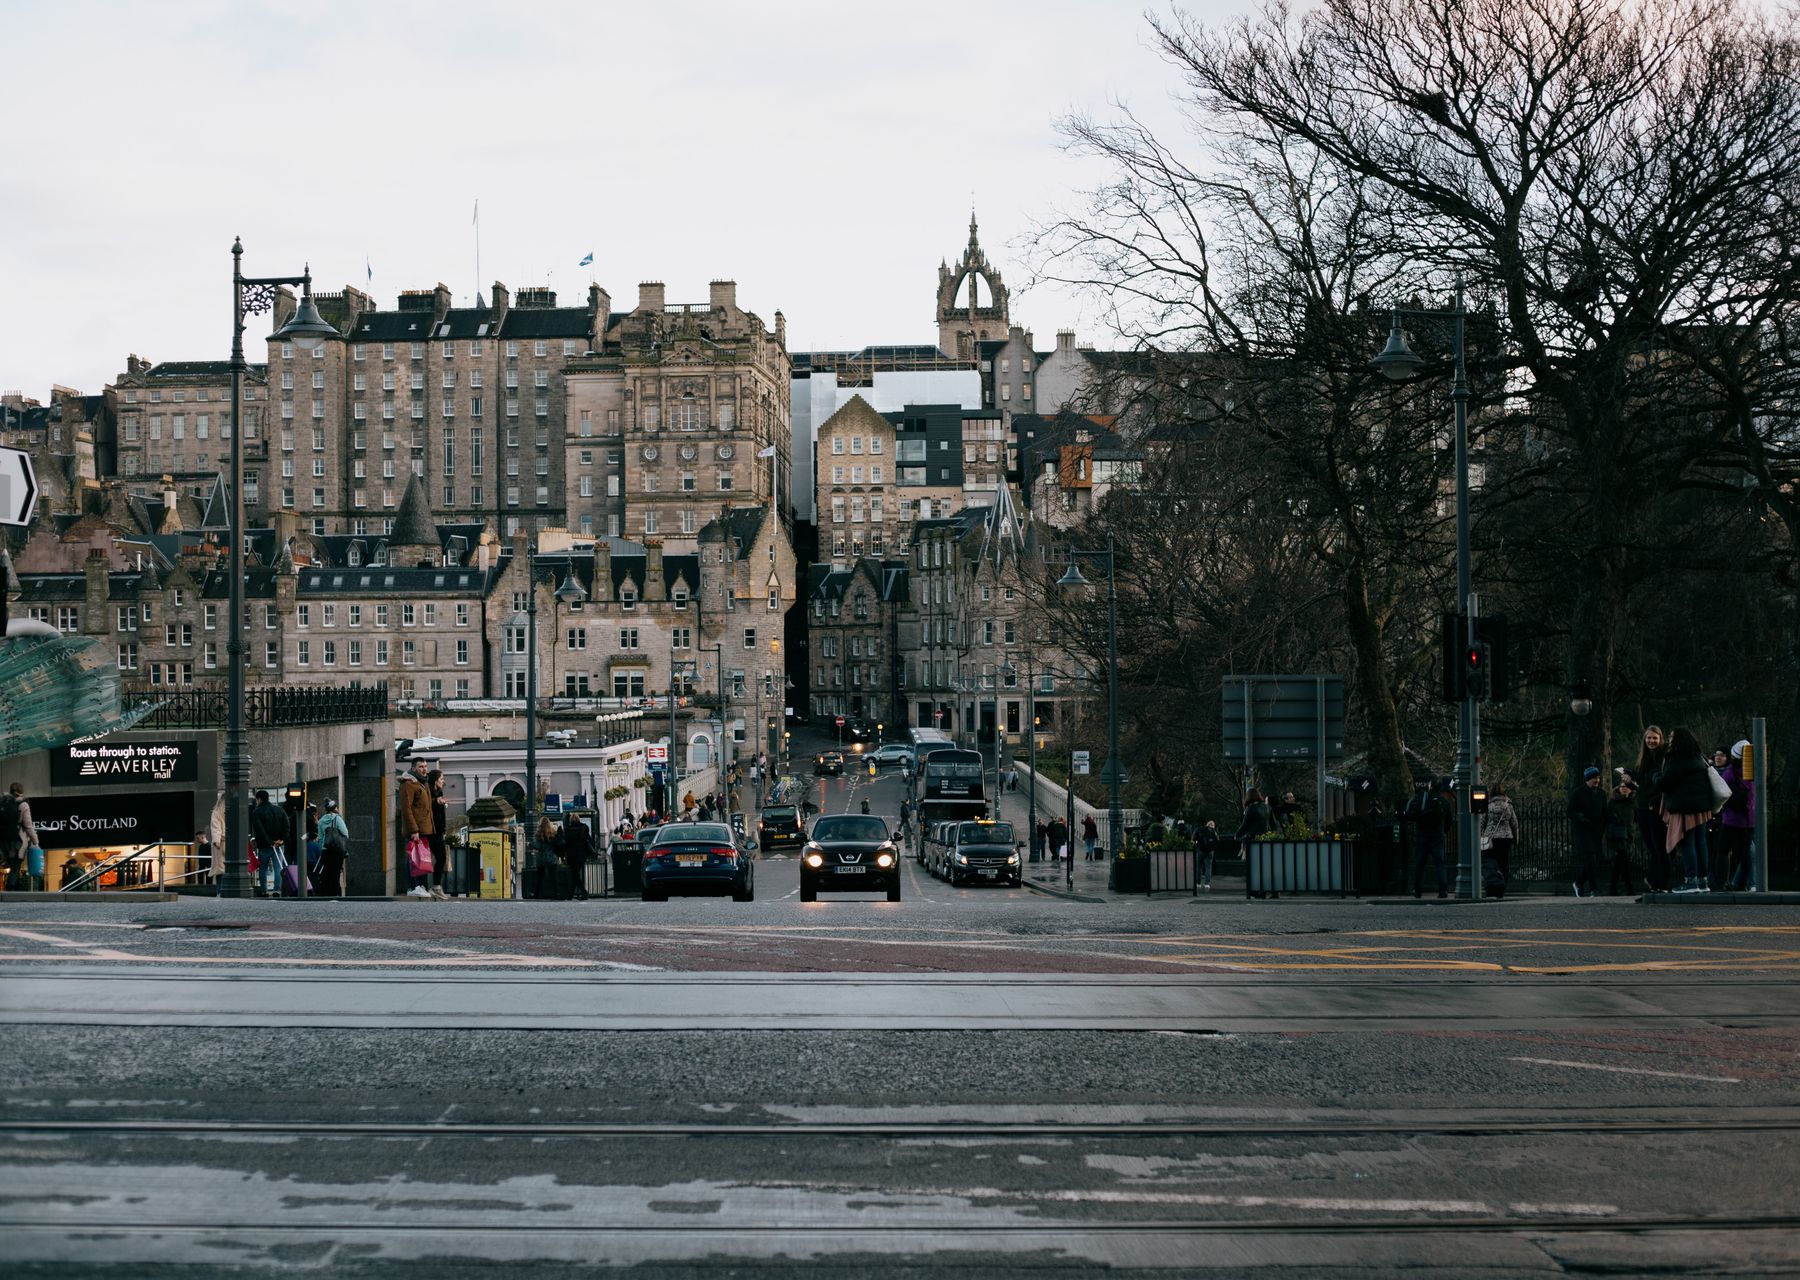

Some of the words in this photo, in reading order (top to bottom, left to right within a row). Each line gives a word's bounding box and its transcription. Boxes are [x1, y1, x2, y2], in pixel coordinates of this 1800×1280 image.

[70, 747, 97, 758] Route
[99, 745, 134, 759] through
[136, 747, 147, 756] to
[149, 746, 181, 756] station.
[95, 759, 177, 773] WAVERLEY
[154, 768, 171, 779] mall
[50, 820, 67, 831] OF
[69, 815, 138, 831] SCOTLAND
